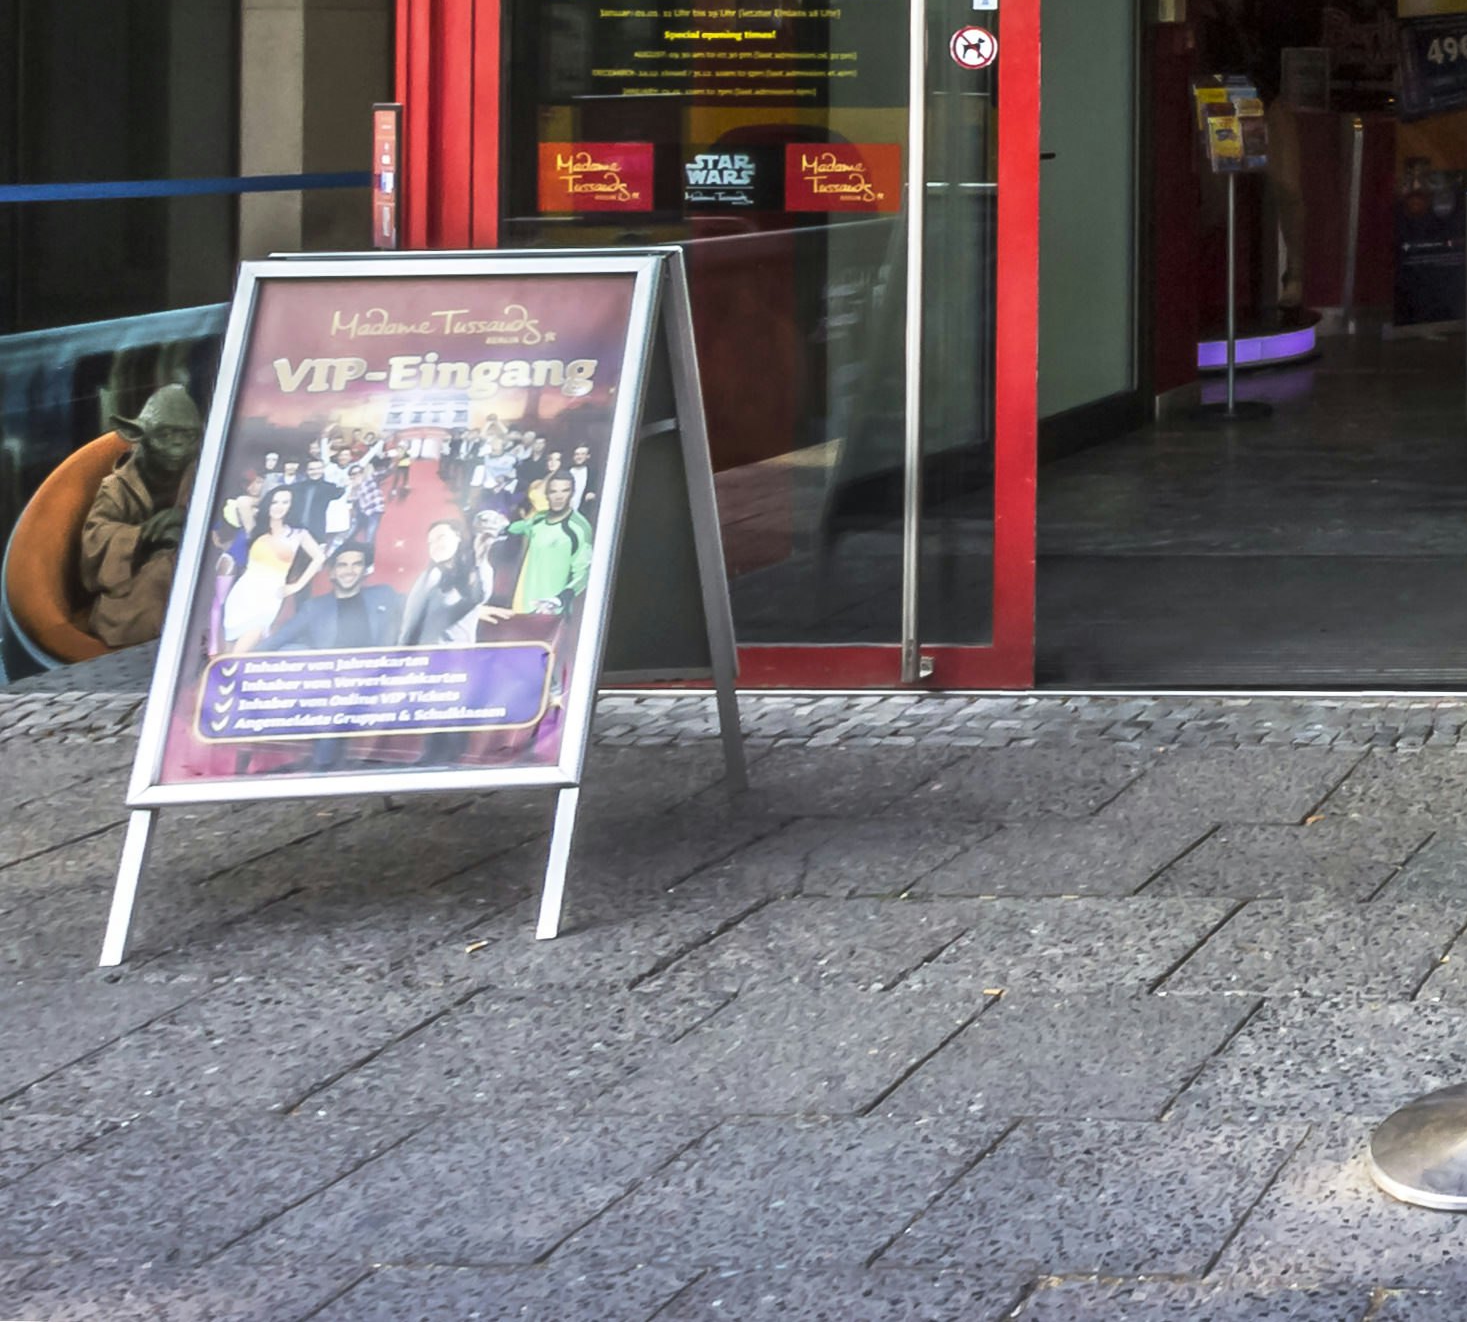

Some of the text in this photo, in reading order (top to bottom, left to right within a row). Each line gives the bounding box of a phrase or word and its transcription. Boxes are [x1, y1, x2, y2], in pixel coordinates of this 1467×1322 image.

[664, 30, 700, 41] Special
[685, 154, 755, 169] STAR
[686, 168, 755, 185] WARS
[331, 304, 542, 345] Madame Tussauds
[273, 351, 598, 399] VIP-Eingang
[244, 659, 307, 674] Inhaber
[308, 661, 333, 671] von
[241, 677, 303, 692] Inhaber
[305, 679, 331, 689] von
[238, 696, 298, 711] Inhaber
[300, 697, 327, 708] von
[379, 692, 406, 704] VIP
[409, 690, 460, 702] Tickets
[333, 713, 396, 727] Gruppen
[399, 710, 411, 721] &
